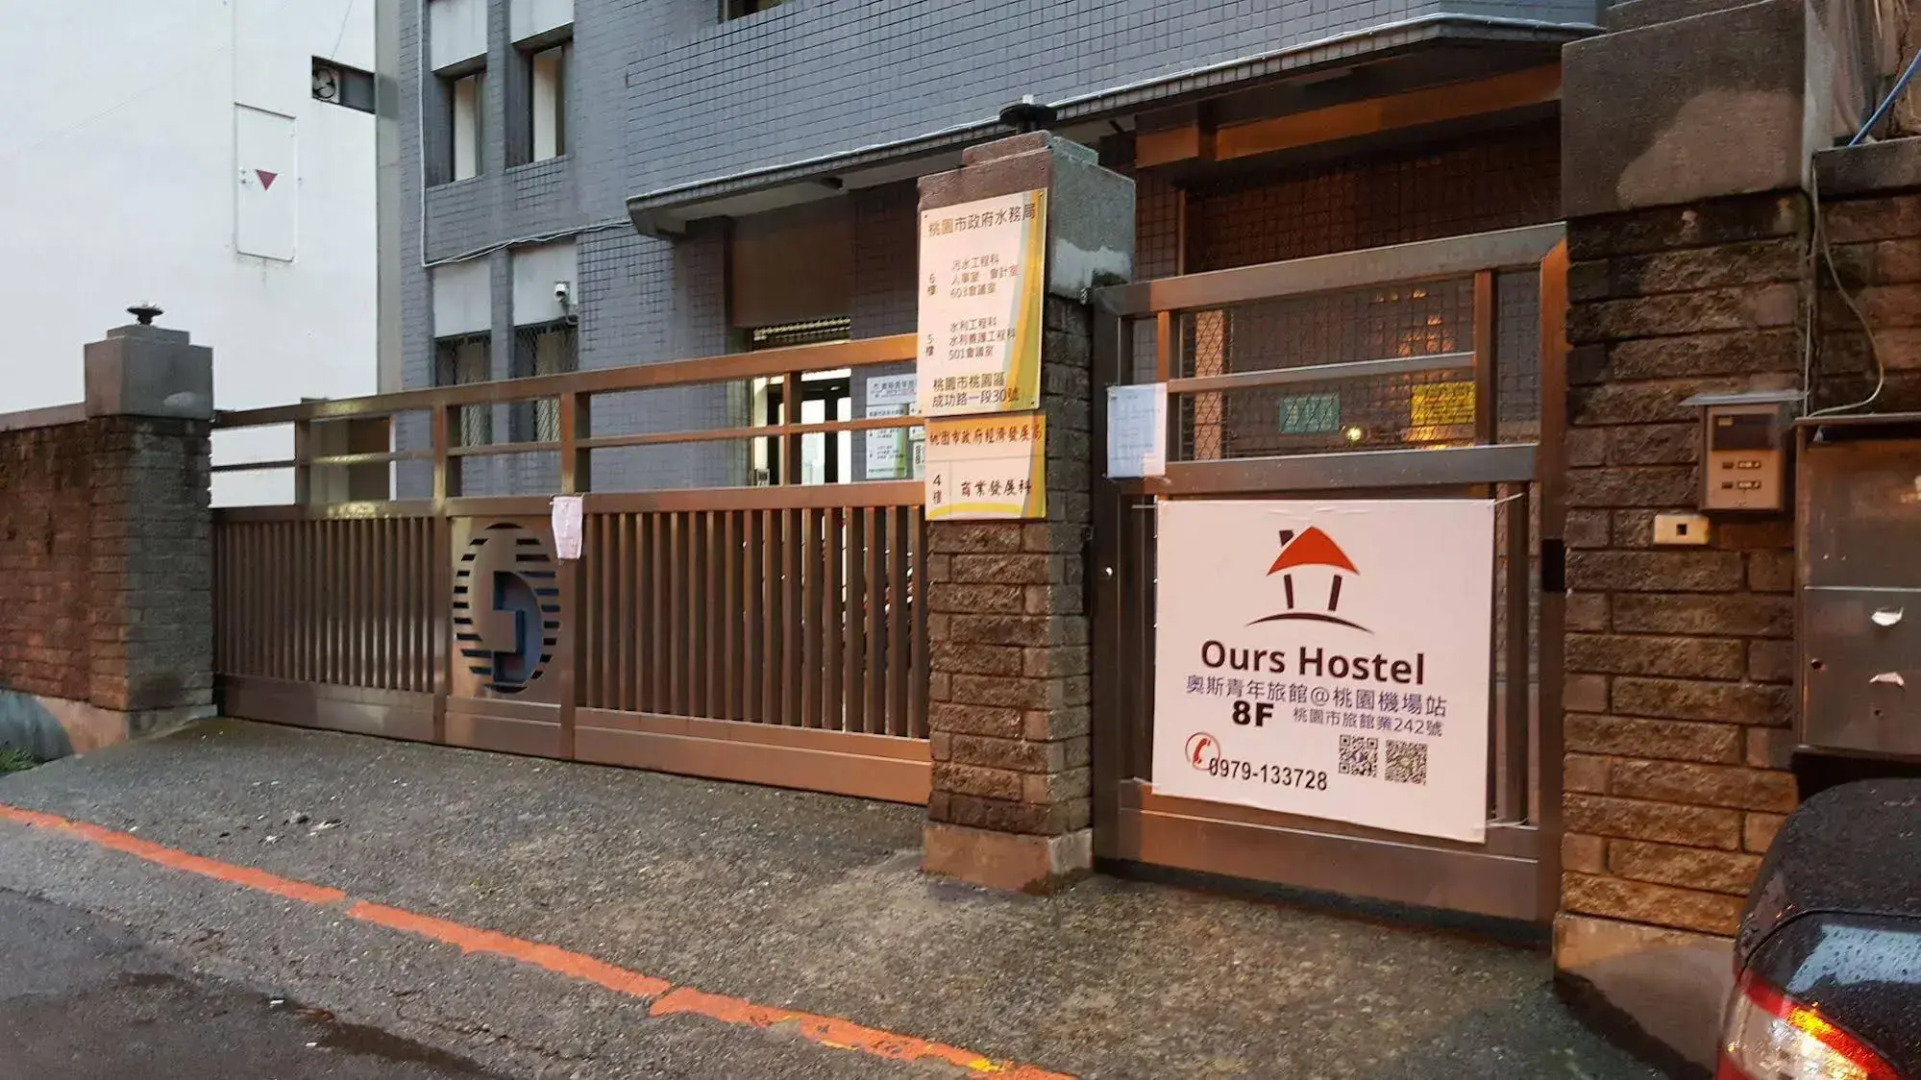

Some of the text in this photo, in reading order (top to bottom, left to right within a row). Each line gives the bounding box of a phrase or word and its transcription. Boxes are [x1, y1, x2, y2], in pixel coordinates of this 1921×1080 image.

[928, 203, 1036, 236] 桃園市政府水務局
[950, 317, 997, 333] 水利工程科
[949, 346, 994, 360] 501會議室
[933, 372, 1005, 392] 桃園市桃園區
[932, 387, 1019, 408] 成功路一段30號
[930, 423, 1042, 446] 桃園市政府經濟發展局
[961, 479, 1031, 497] 商業發展科
[1202, 640, 1425, 685] Ours Hostel
[1186, 674, 1448, 717] 奧斯青年旅館@桃園機場站
[1232, 700, 1275, 727] 8F
[1293, 707, 1444, 737] 桃園市旅館業242號
[1209, 757, 1328, 791] 0979-133728
